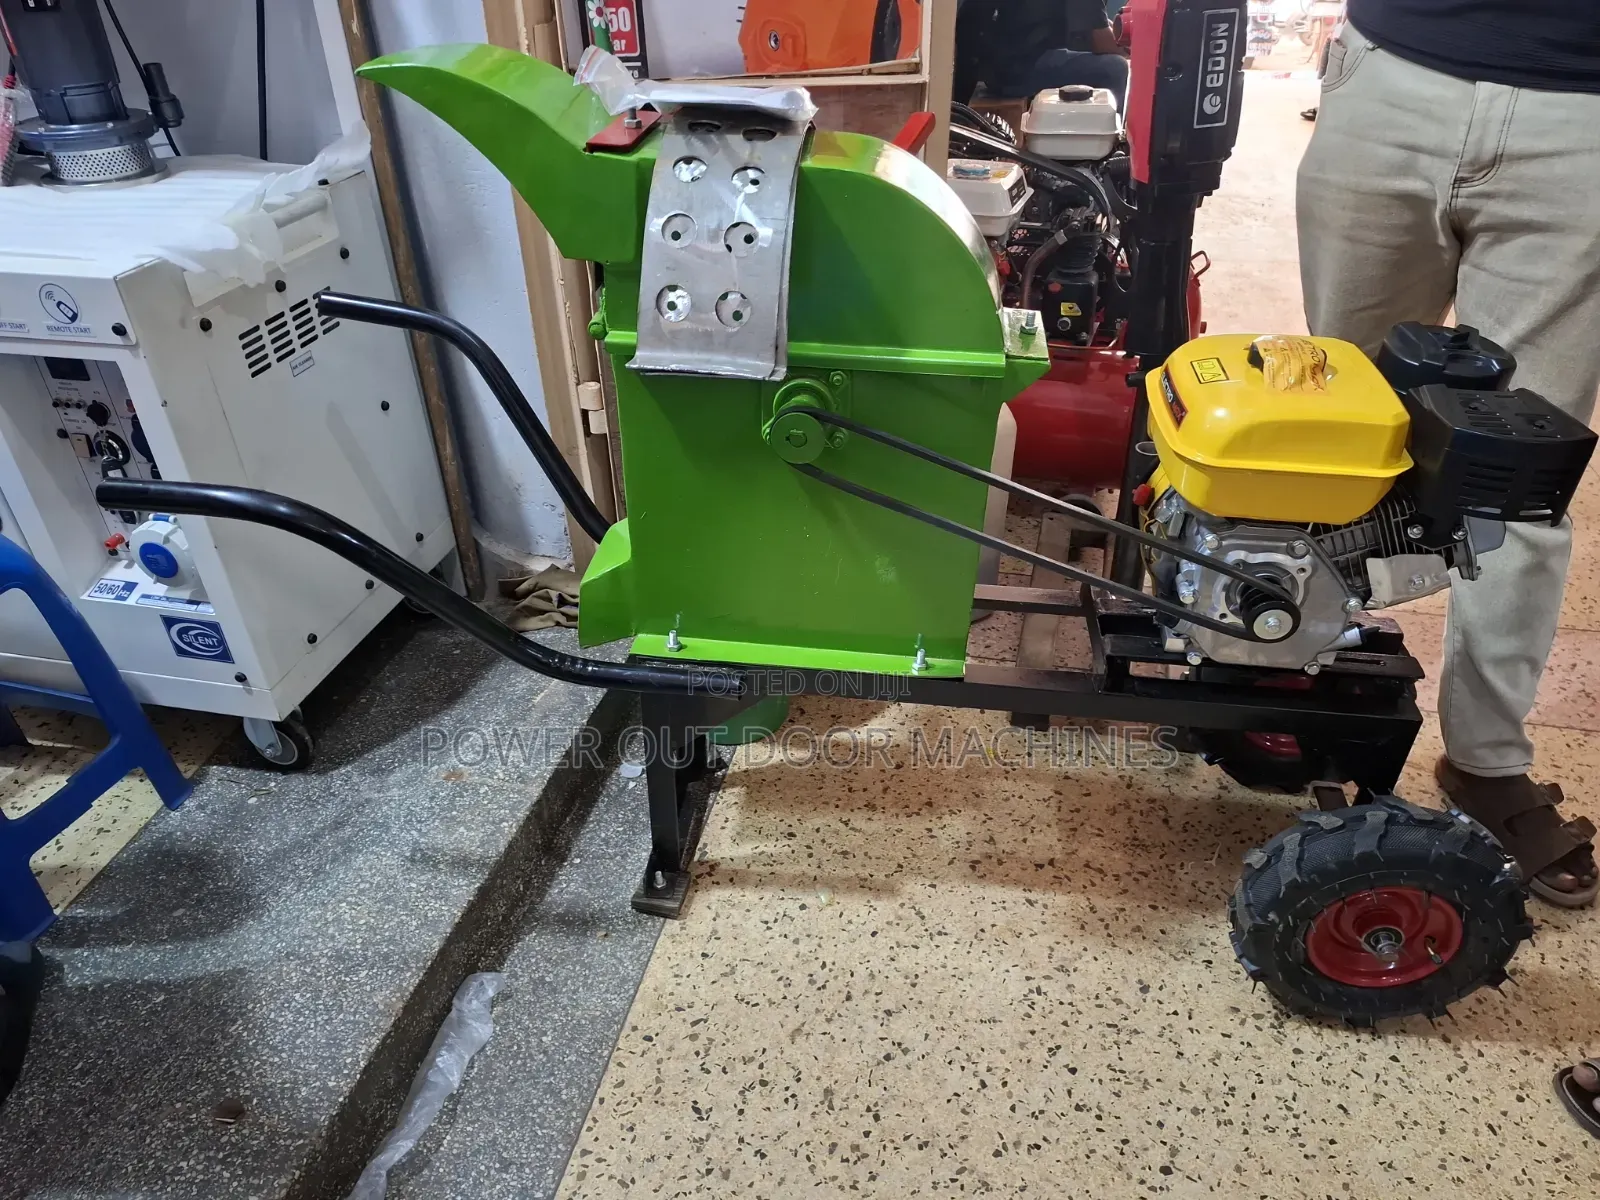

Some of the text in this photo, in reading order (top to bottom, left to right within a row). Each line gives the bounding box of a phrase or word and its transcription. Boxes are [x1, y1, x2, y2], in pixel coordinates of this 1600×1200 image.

[46, 325, 91, 334] REMOTE START
[94, 583, 130, 597] 50/60 Hz
[182, 634, 218, 646] SILENT
